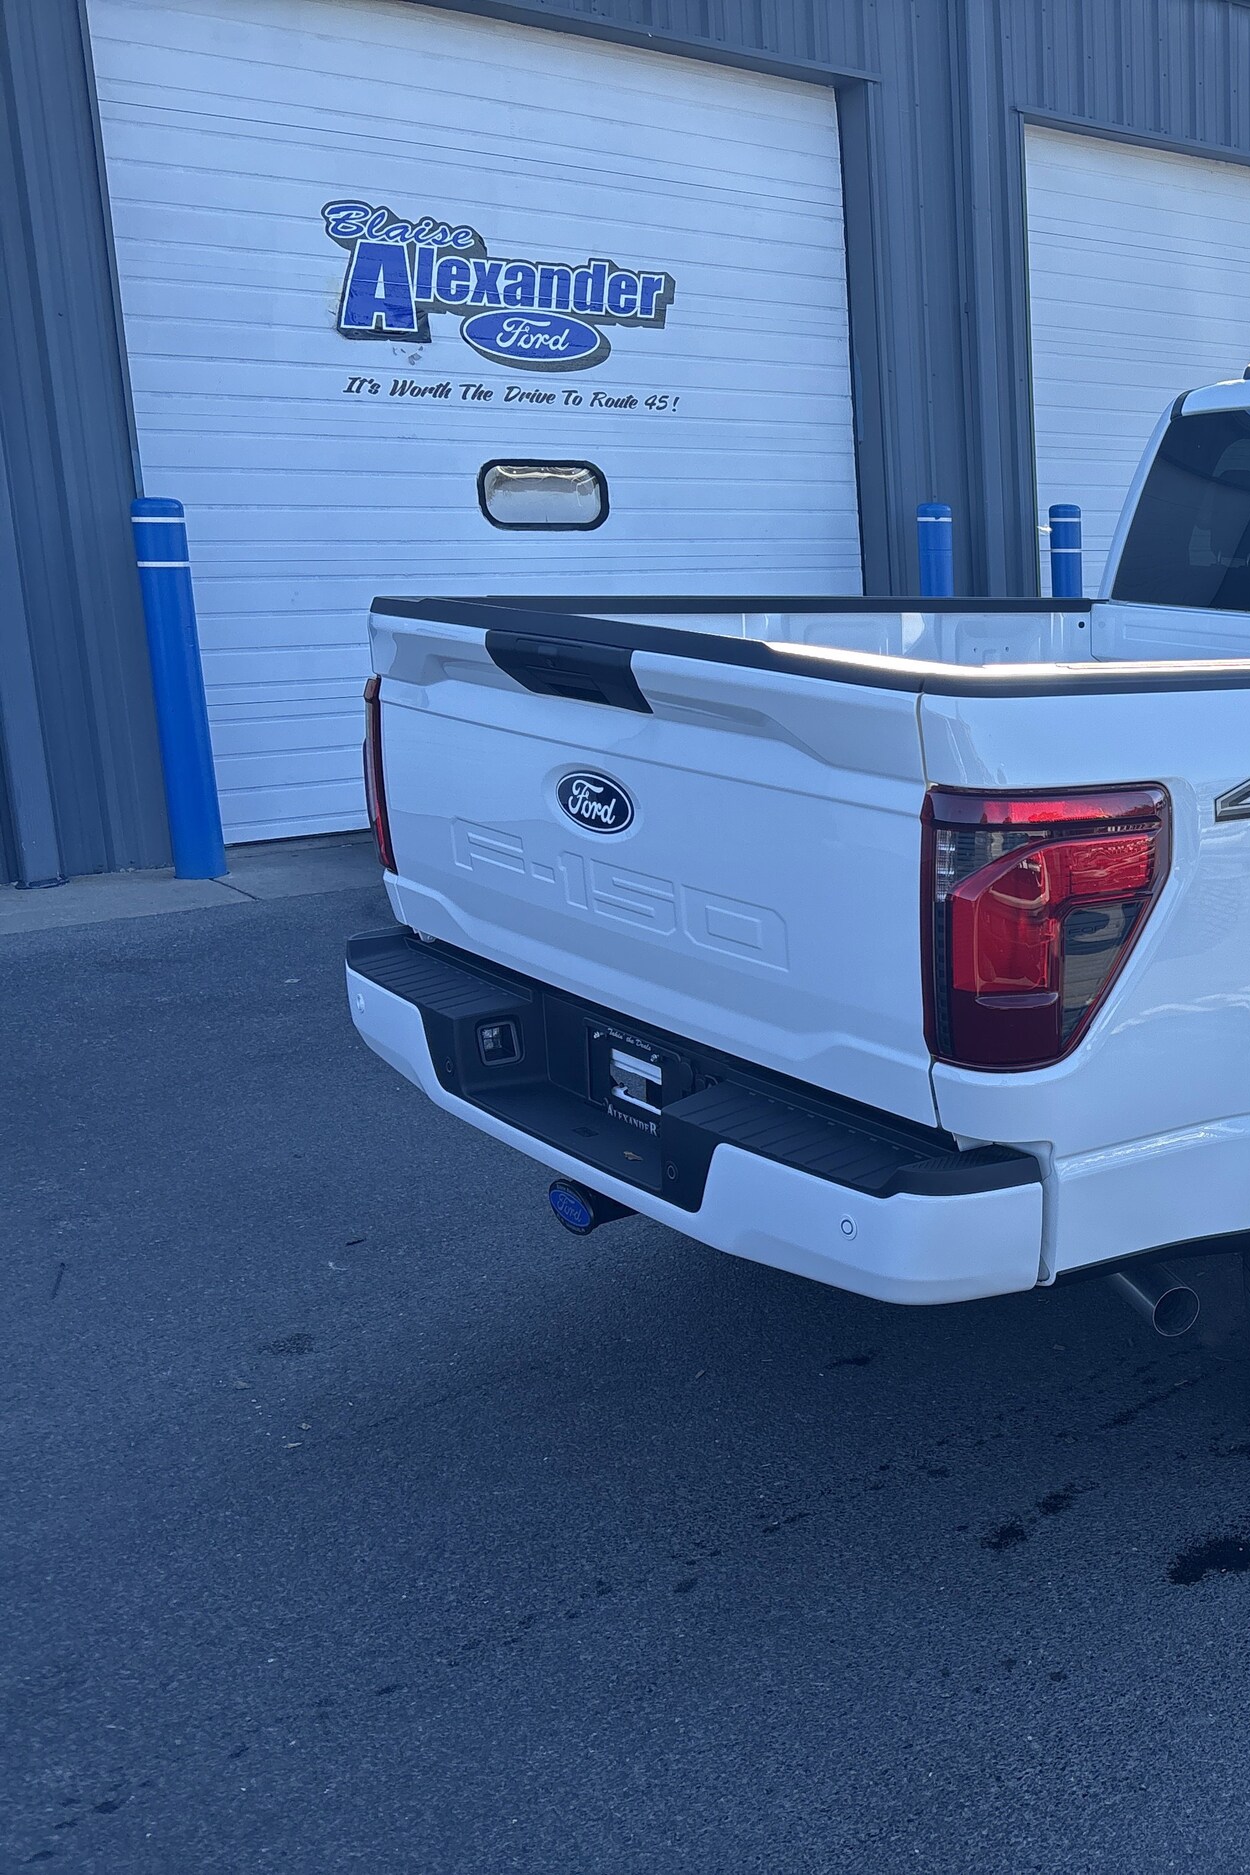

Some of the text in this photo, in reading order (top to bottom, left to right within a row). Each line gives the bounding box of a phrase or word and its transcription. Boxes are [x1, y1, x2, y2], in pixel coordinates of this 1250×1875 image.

[323, 202, 475, 250] Blaise
[340, 238, 666, 332] Alexander
[496, 316, 570, 352] Ford
[342, 376, 379, 396] It's
[388, 378, 453, 400] Worth
[459, 383, 493, 403] The
[504, 385, 556, 407] Drive
[561, 389, 583, 408] To
[589, 391, 640, 411] Route
[568, 779, 616, 825] Ford
[450, 815, 790, 973] F-150
[556, 1193, 582, 1220] Ford
